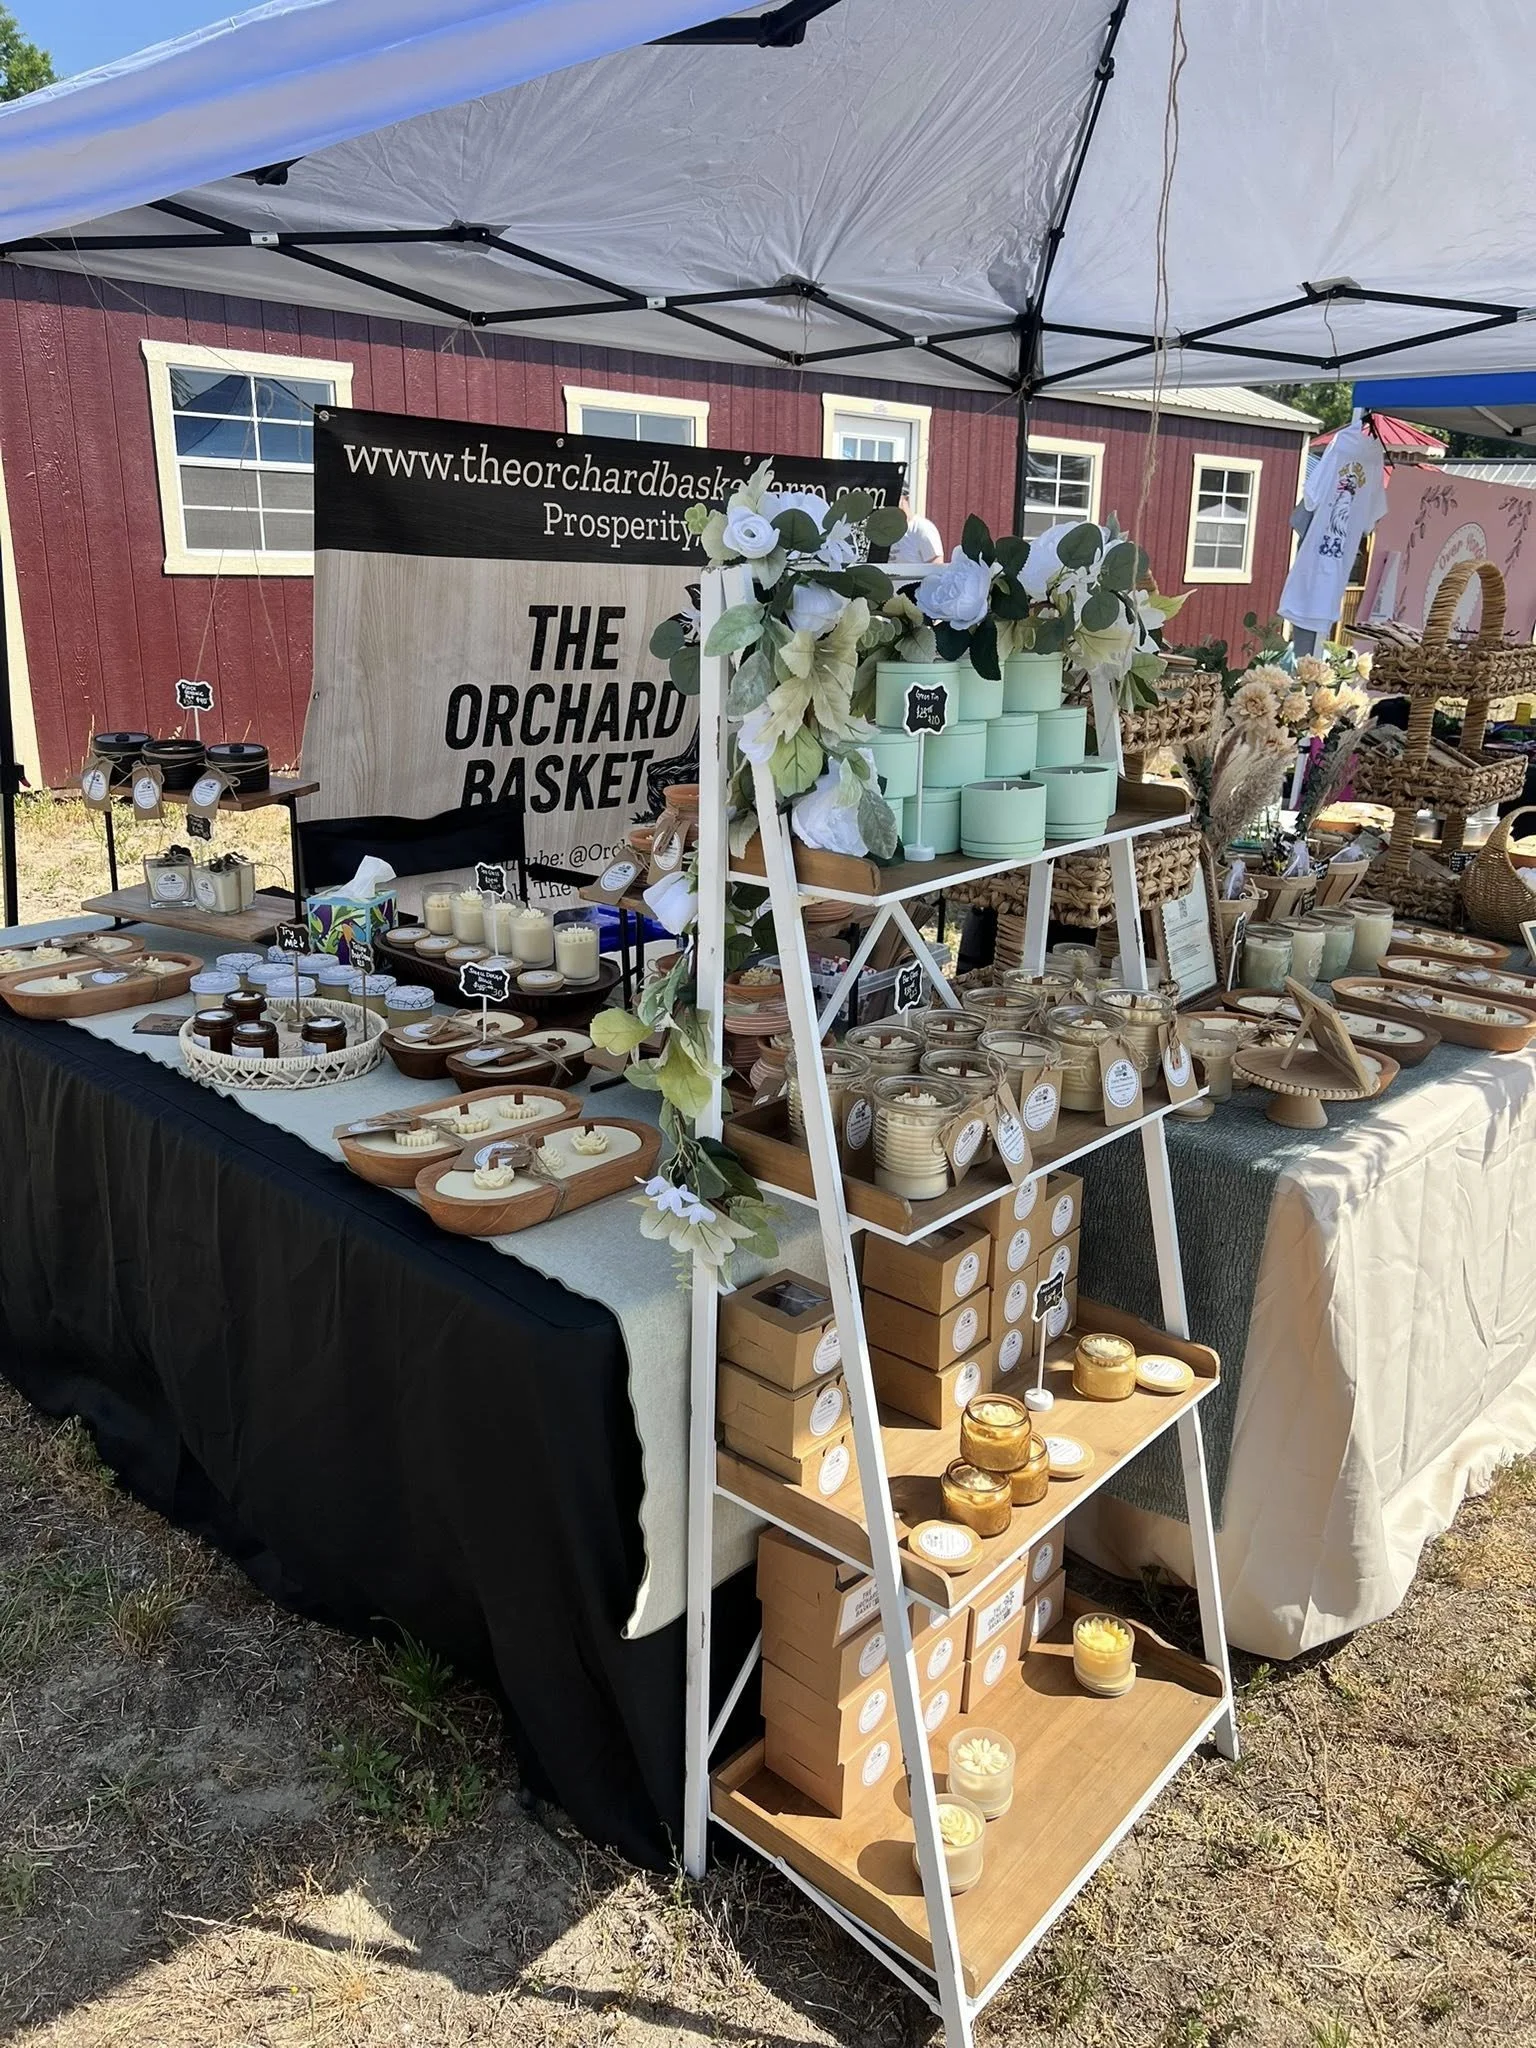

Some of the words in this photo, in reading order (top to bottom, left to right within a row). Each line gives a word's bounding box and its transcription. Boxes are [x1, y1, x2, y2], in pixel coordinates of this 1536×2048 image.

[343, 443, 887, 508] www.theorchardbaskearm.cm
[528, 605, 626, 671] THE
[445, 681, 687, 752] ORCHARD
[461, 749, 654, 814] BASKET
[280, 926, 294, 939] Try
[284, 939, 299, 949] Me
